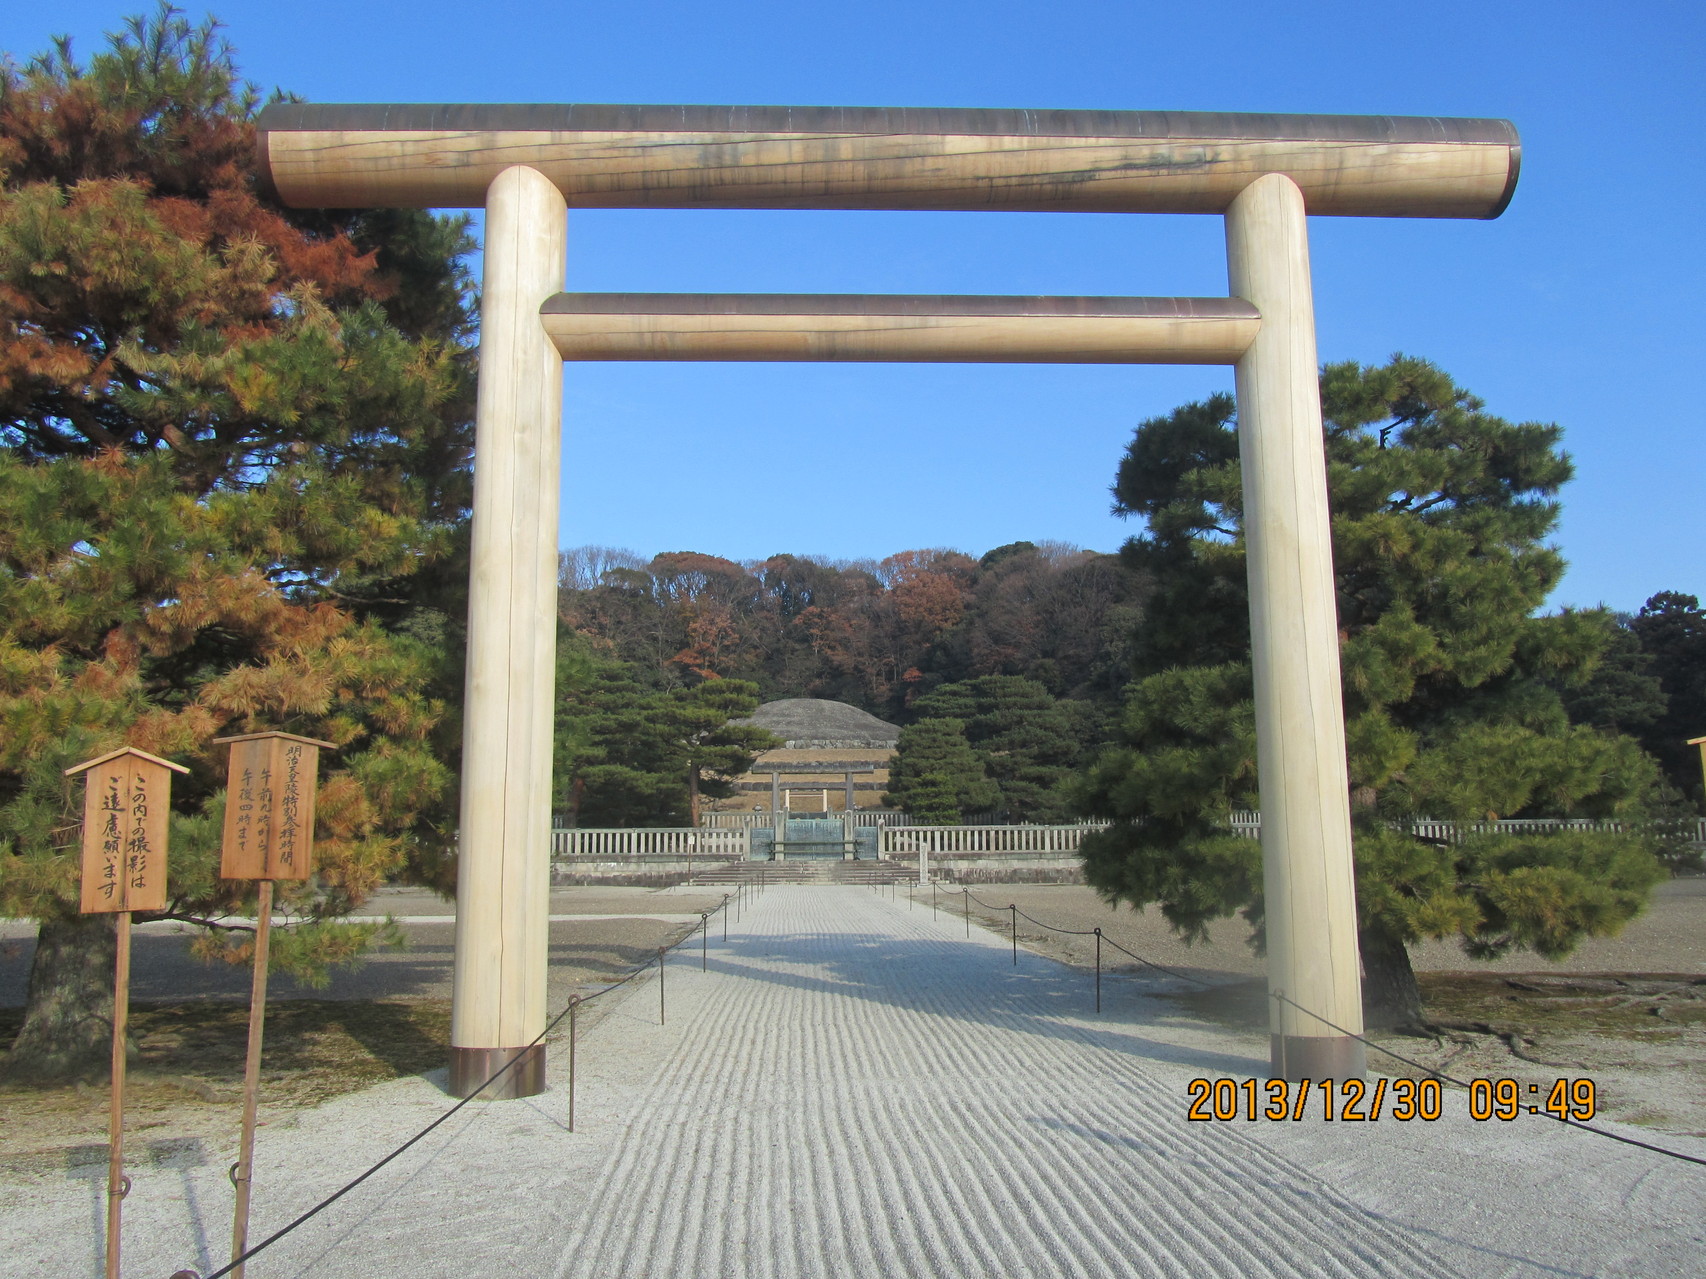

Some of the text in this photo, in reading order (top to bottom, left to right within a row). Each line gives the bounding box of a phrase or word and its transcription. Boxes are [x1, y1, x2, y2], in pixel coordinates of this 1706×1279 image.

[97, 776, 126, 899] ご遠慮願います
[127, 773, 152, 889] この内での撮影は
[236, 768, 255, 851] 午後四時まで
[257, 768, 273, 850] 午前九時から
